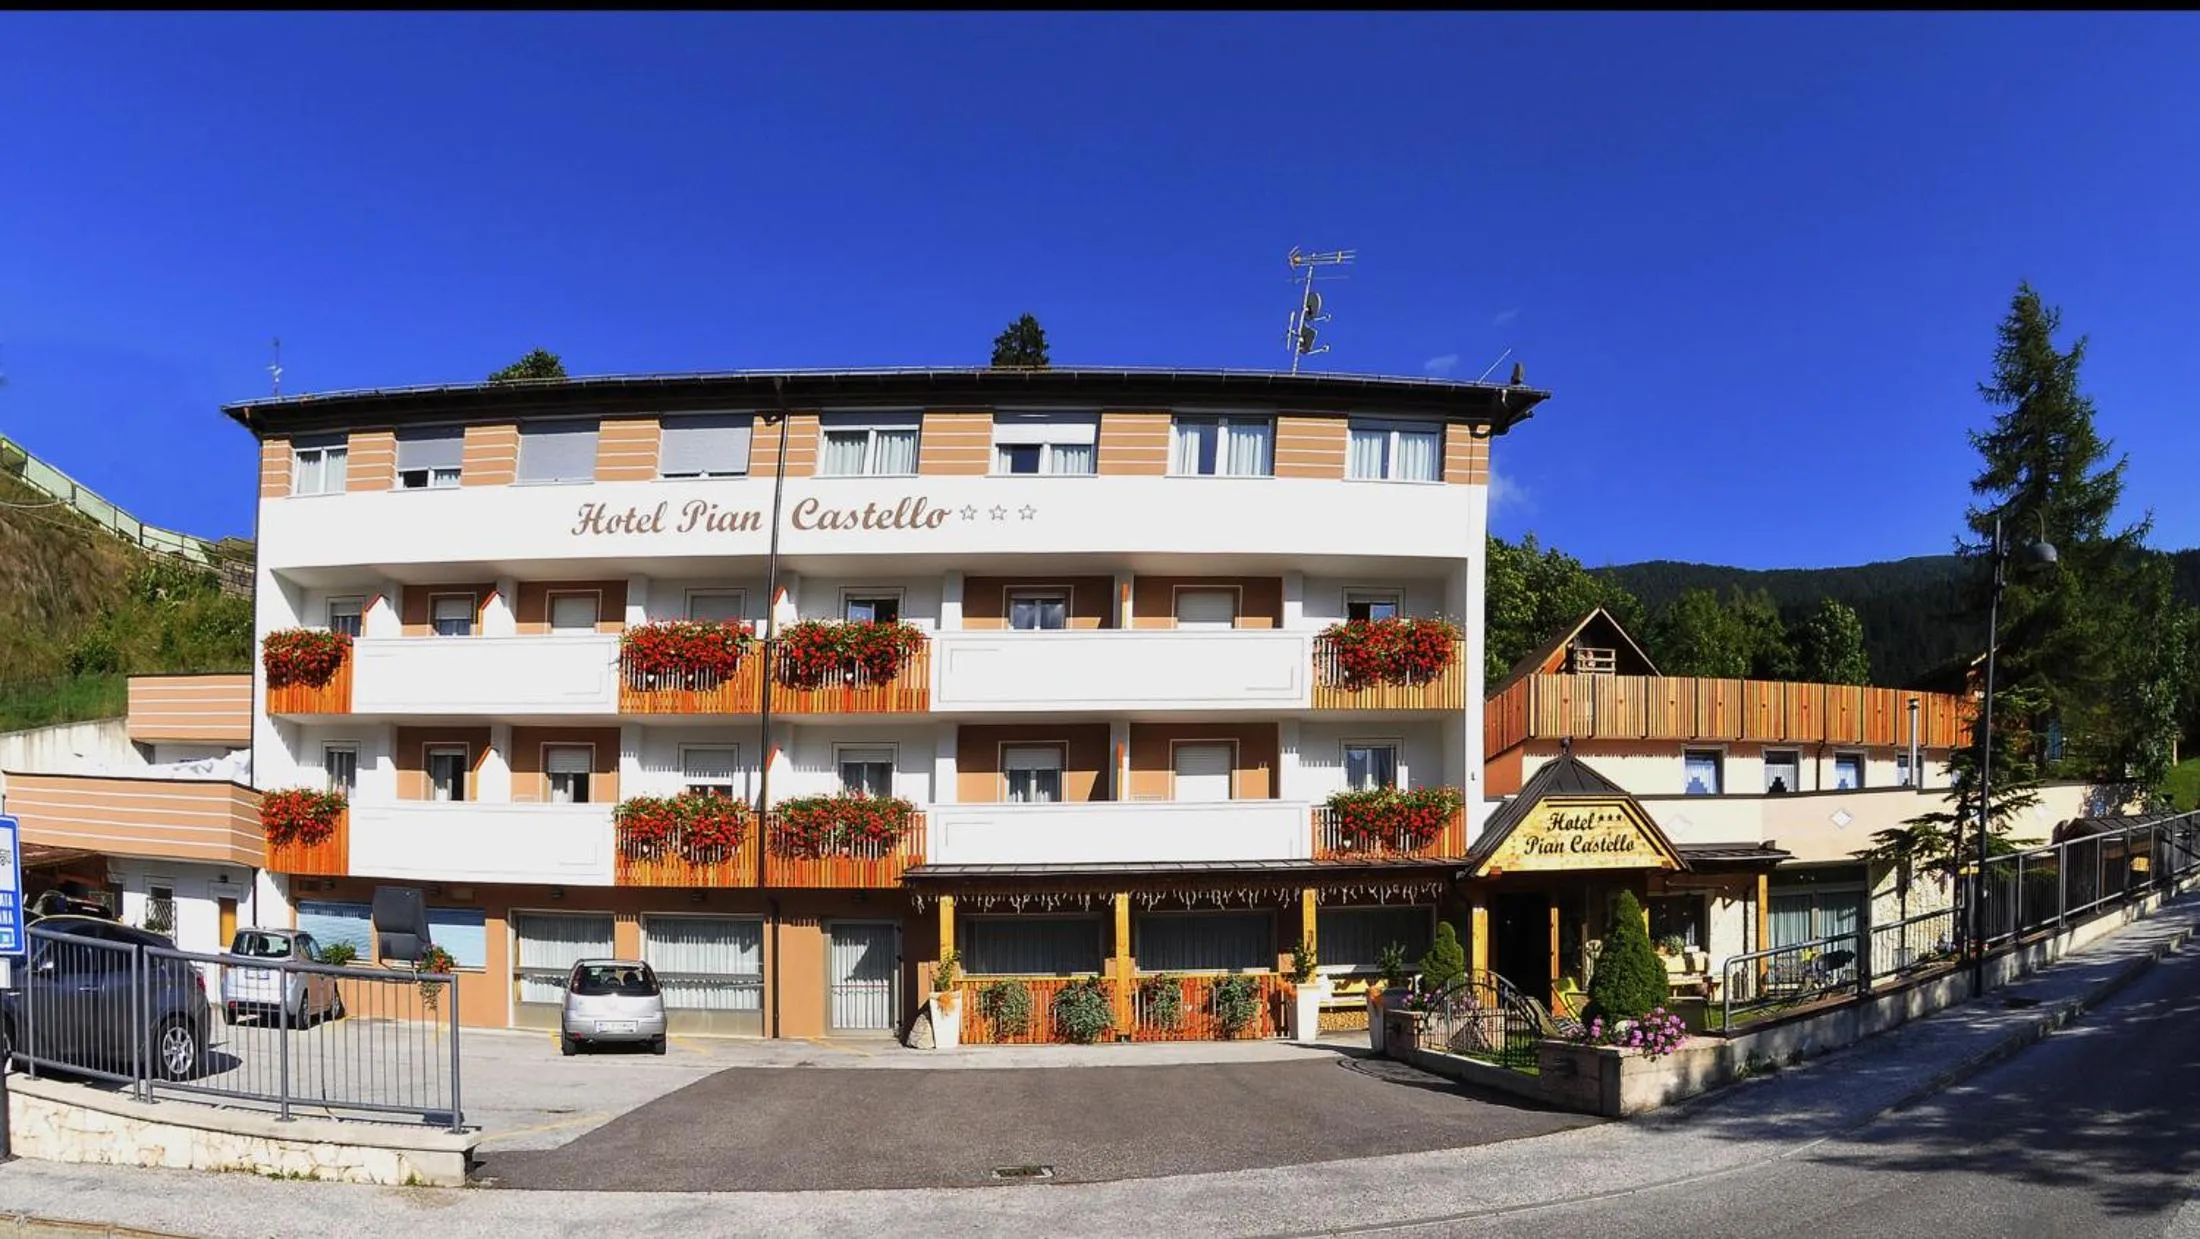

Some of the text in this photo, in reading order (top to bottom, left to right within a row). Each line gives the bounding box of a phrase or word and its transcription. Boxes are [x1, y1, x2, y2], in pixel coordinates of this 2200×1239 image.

[571, 496, 952, 536] Hotel Pian Castello
[1546, 812, 1596, 832] Hotel
[1523, 834, 1635, 855] Pian Castello
